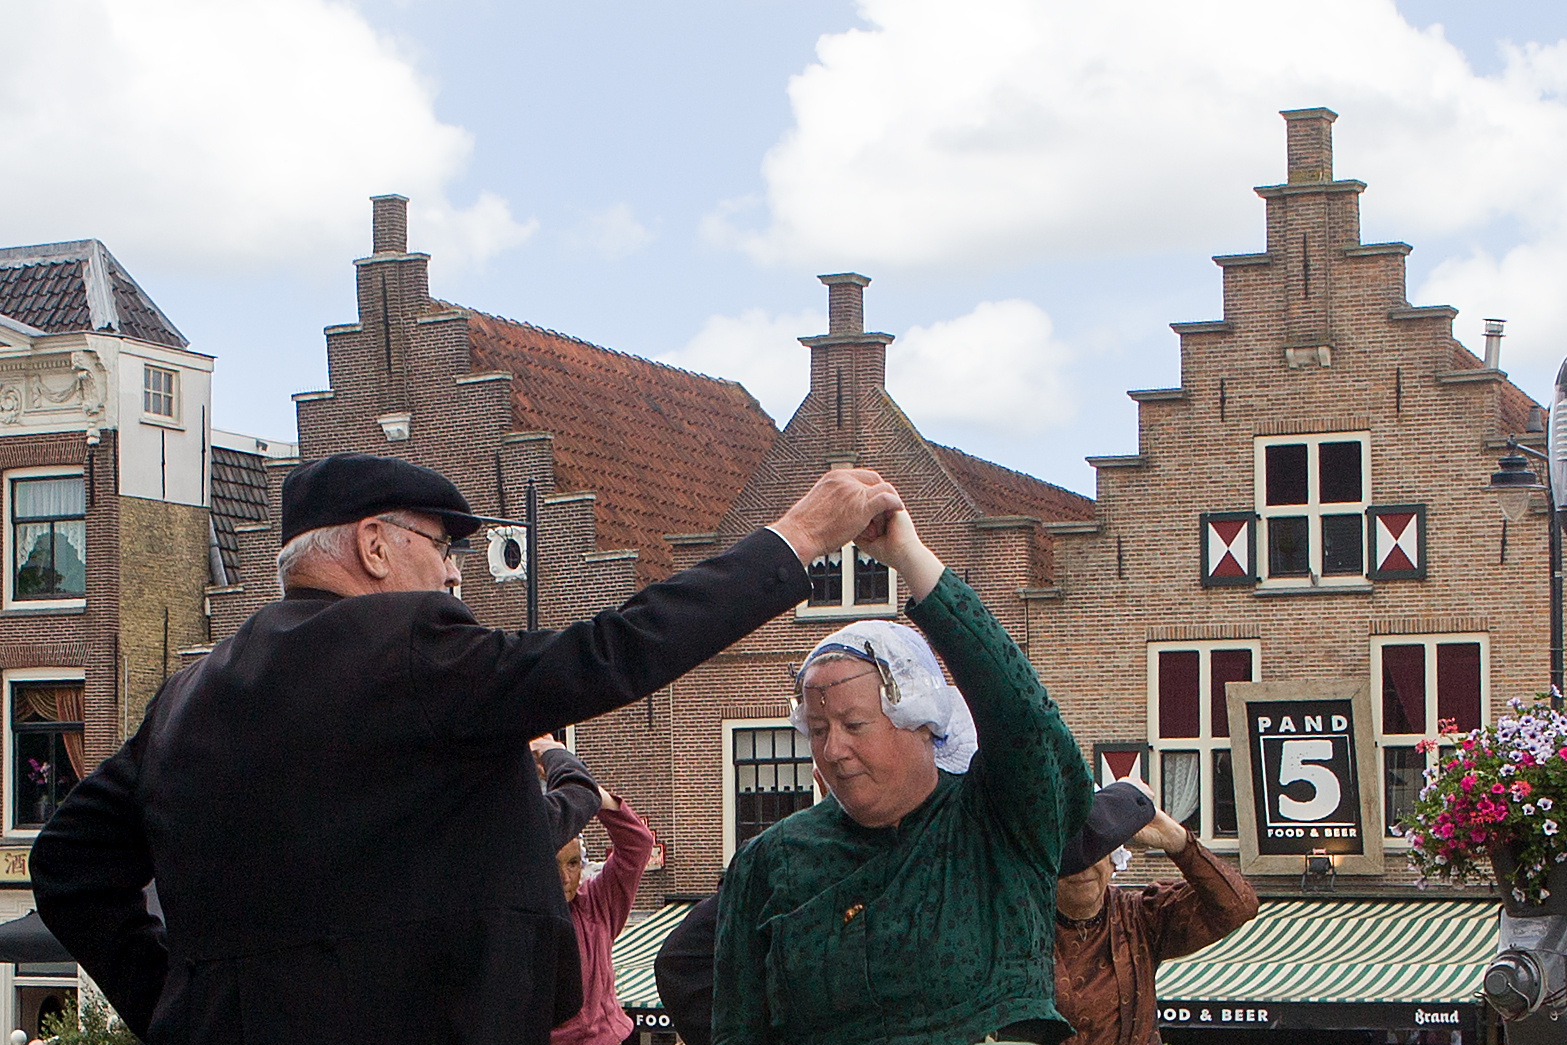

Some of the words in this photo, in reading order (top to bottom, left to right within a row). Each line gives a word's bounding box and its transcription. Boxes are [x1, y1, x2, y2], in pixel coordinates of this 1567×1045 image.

[1257, 714, 1348, 733] PAND
[1278, 738, 1341, 821] 5
[1267, 828, 1305, 838] FOOD
[1310, 828, 1320, 838] &
[1324, 828, 1358, 838] BEER
[636, 1014, 675, 1027] FOO
[1157, 1008, 1191, 1021] OD
[1200, 1008, 1212, 1022] &
[1221, 1008, 1269, 1022] BEER
[1415, 1008, 1460, 1025] Brand
